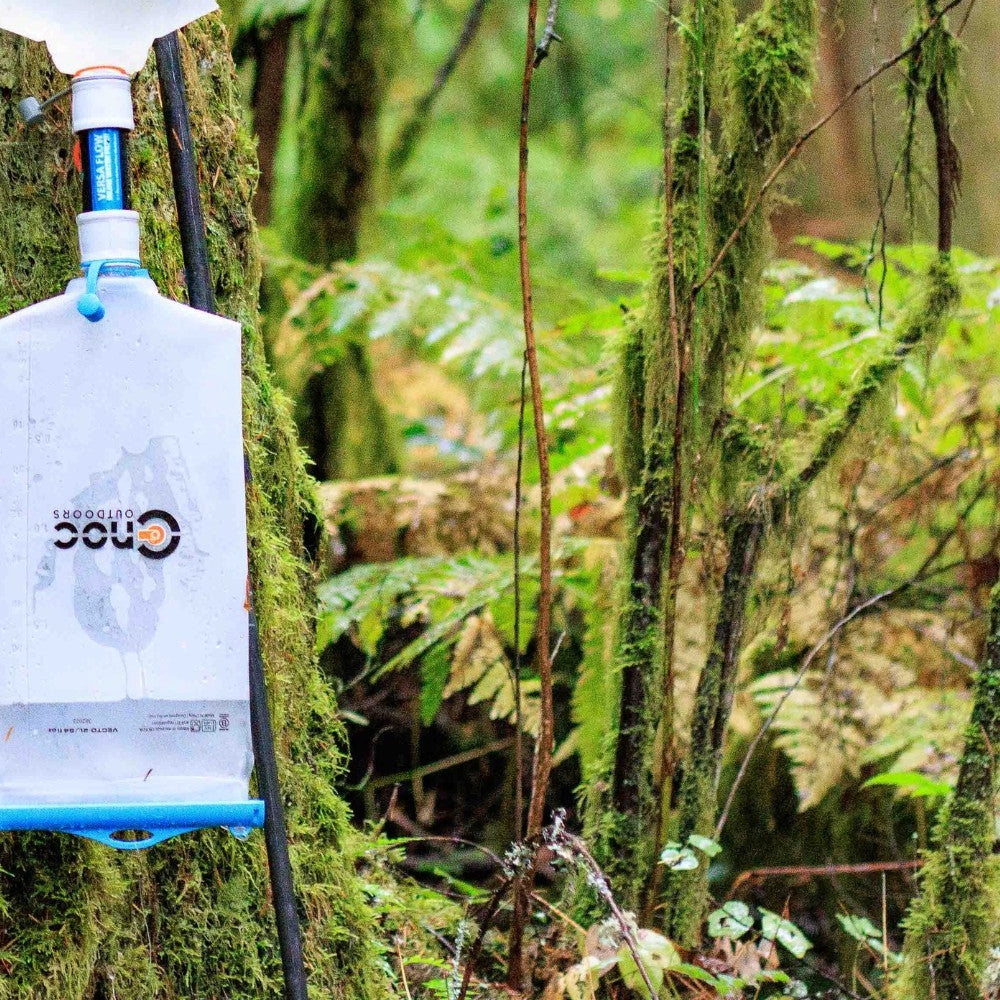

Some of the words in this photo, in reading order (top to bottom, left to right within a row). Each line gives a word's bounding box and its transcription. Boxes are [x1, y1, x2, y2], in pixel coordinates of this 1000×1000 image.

[93, 134, 105, 165] FLOW
[95, 166, 106, 201] VERSA
[53, 509, 134, 519] OUTDOORS
[53, 510, 181, 560] Cnoc
